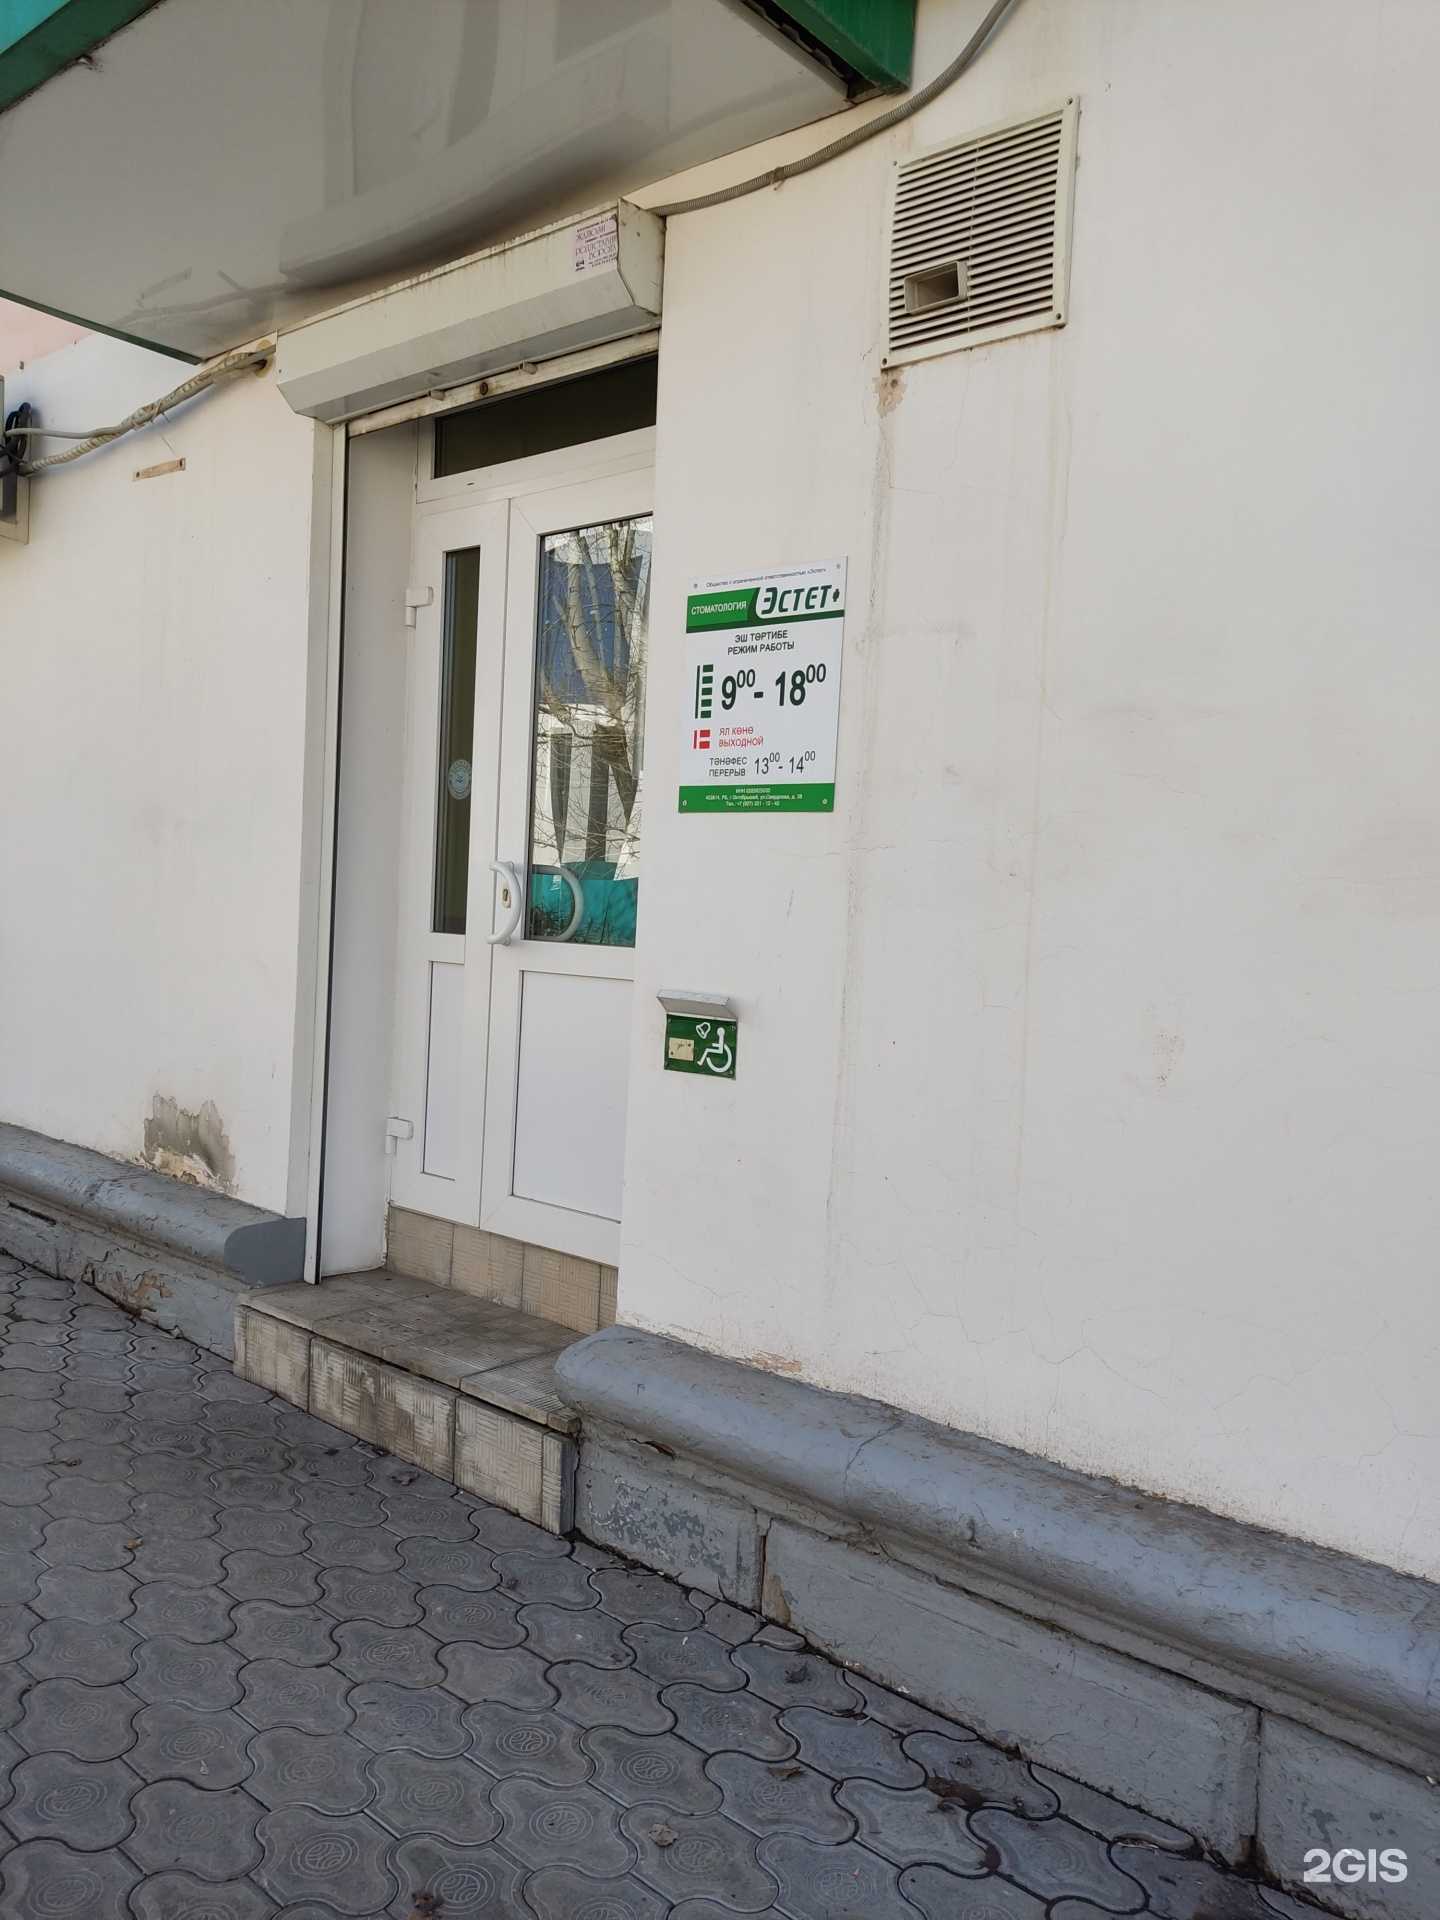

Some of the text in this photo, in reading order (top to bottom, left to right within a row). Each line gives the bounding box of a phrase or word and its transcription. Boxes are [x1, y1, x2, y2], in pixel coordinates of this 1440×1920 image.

[691, 601, 747, 615] СТОМАТОЛОГИЯ
[735, 629, 788, 643] ЭШ ТӨРТИБЕ
[727, 640, 795, 656] РЕЖИМ РАБОТЫ
[719, 727, 730, 736] ЯЛ
[718, 735, 764, 749] ВЫХОДНОЙ
[708, 768, 747, 777] ПЕРЕРЫВ
